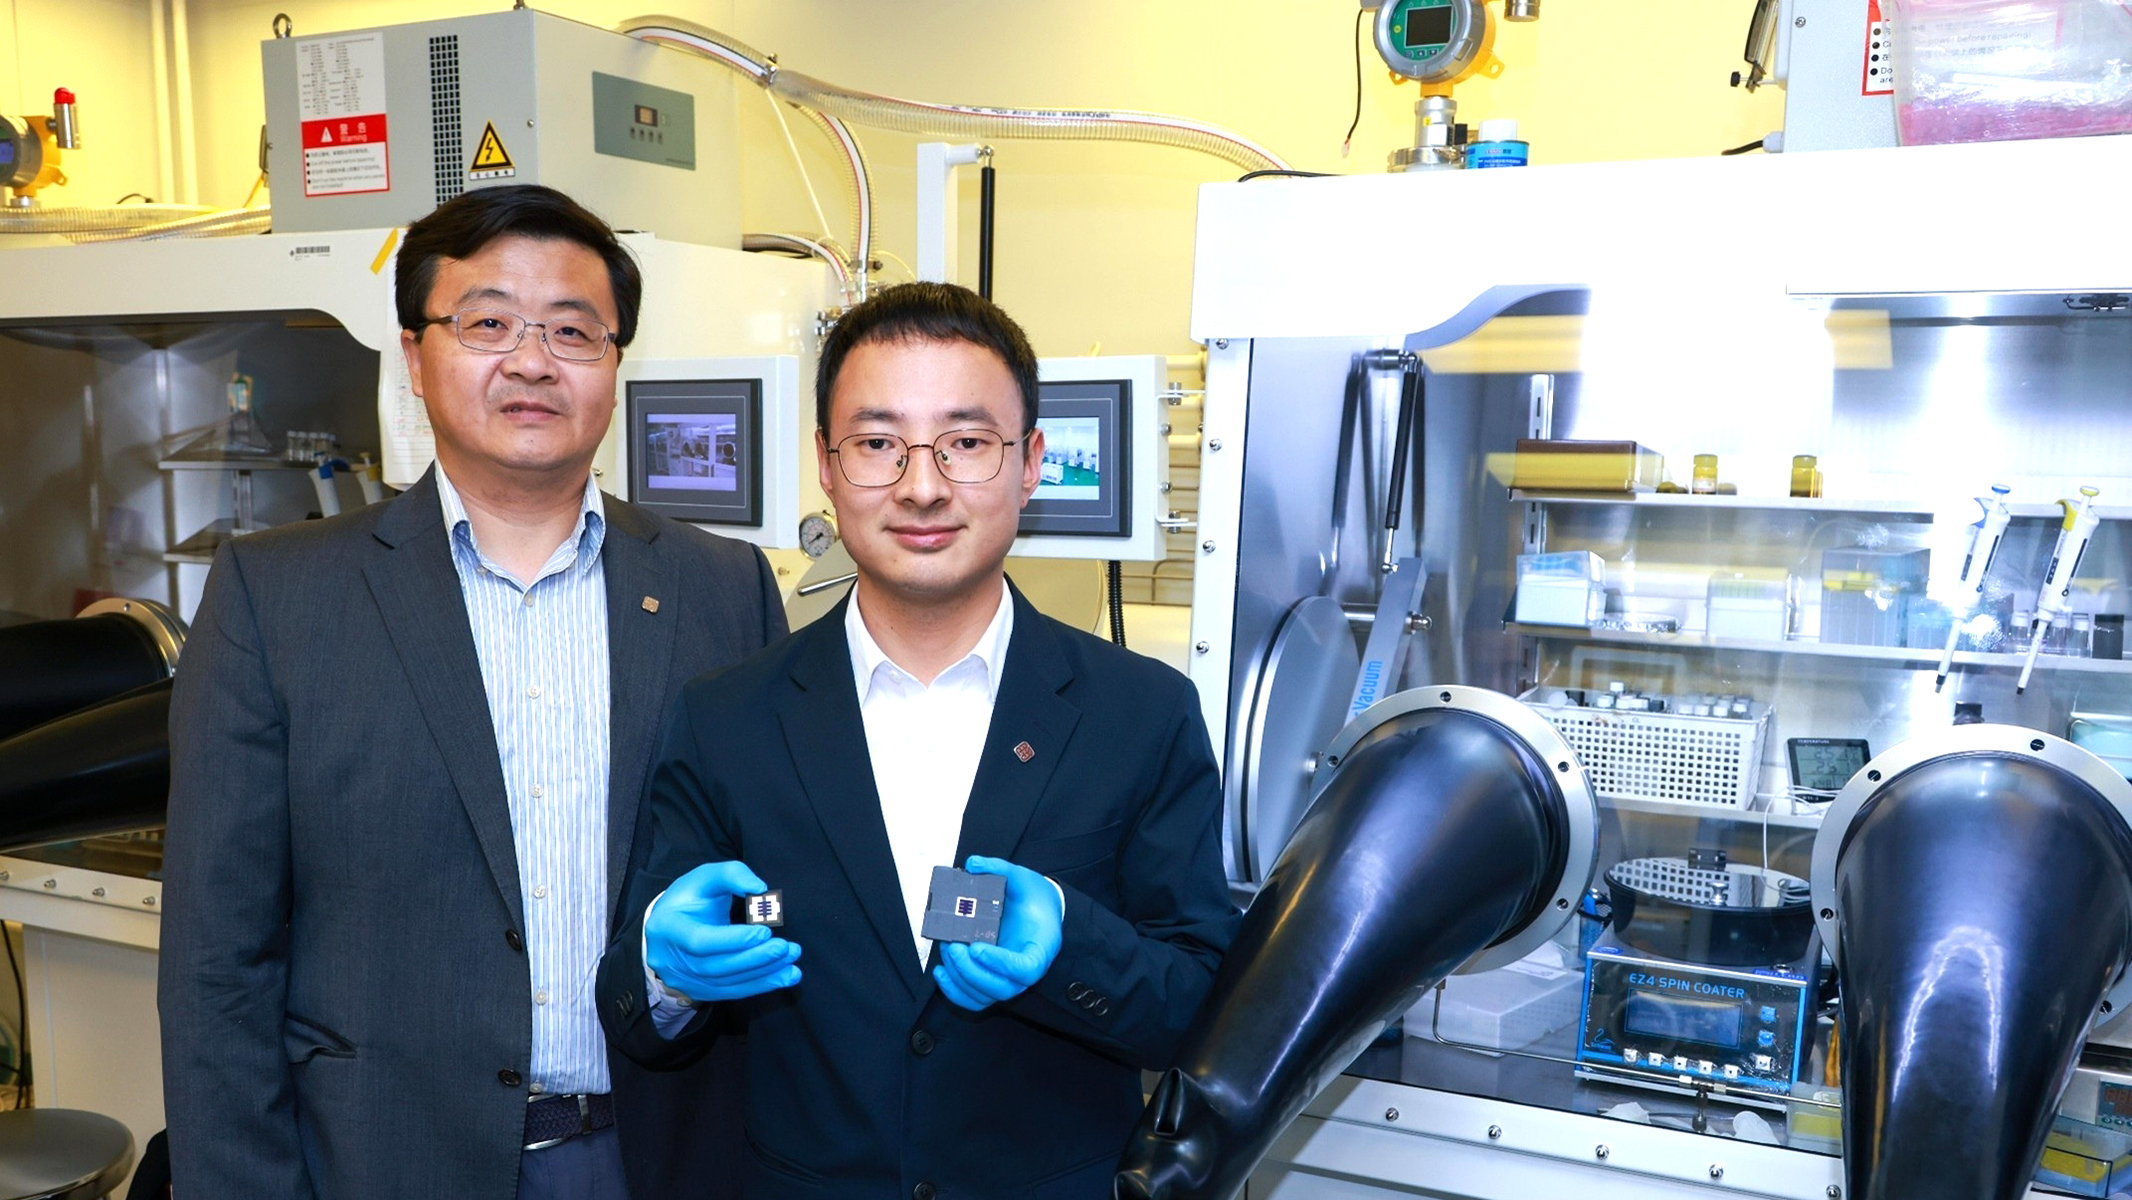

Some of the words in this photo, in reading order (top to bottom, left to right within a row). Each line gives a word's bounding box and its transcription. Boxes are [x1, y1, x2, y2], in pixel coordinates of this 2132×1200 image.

[1352, 660, 1384, 710] Vacuum
[1629, 972, 1655, 986] EZ4
[1659, 977, 1691, 991] SPIN
[1693, 982, 1745, 999] COATER
